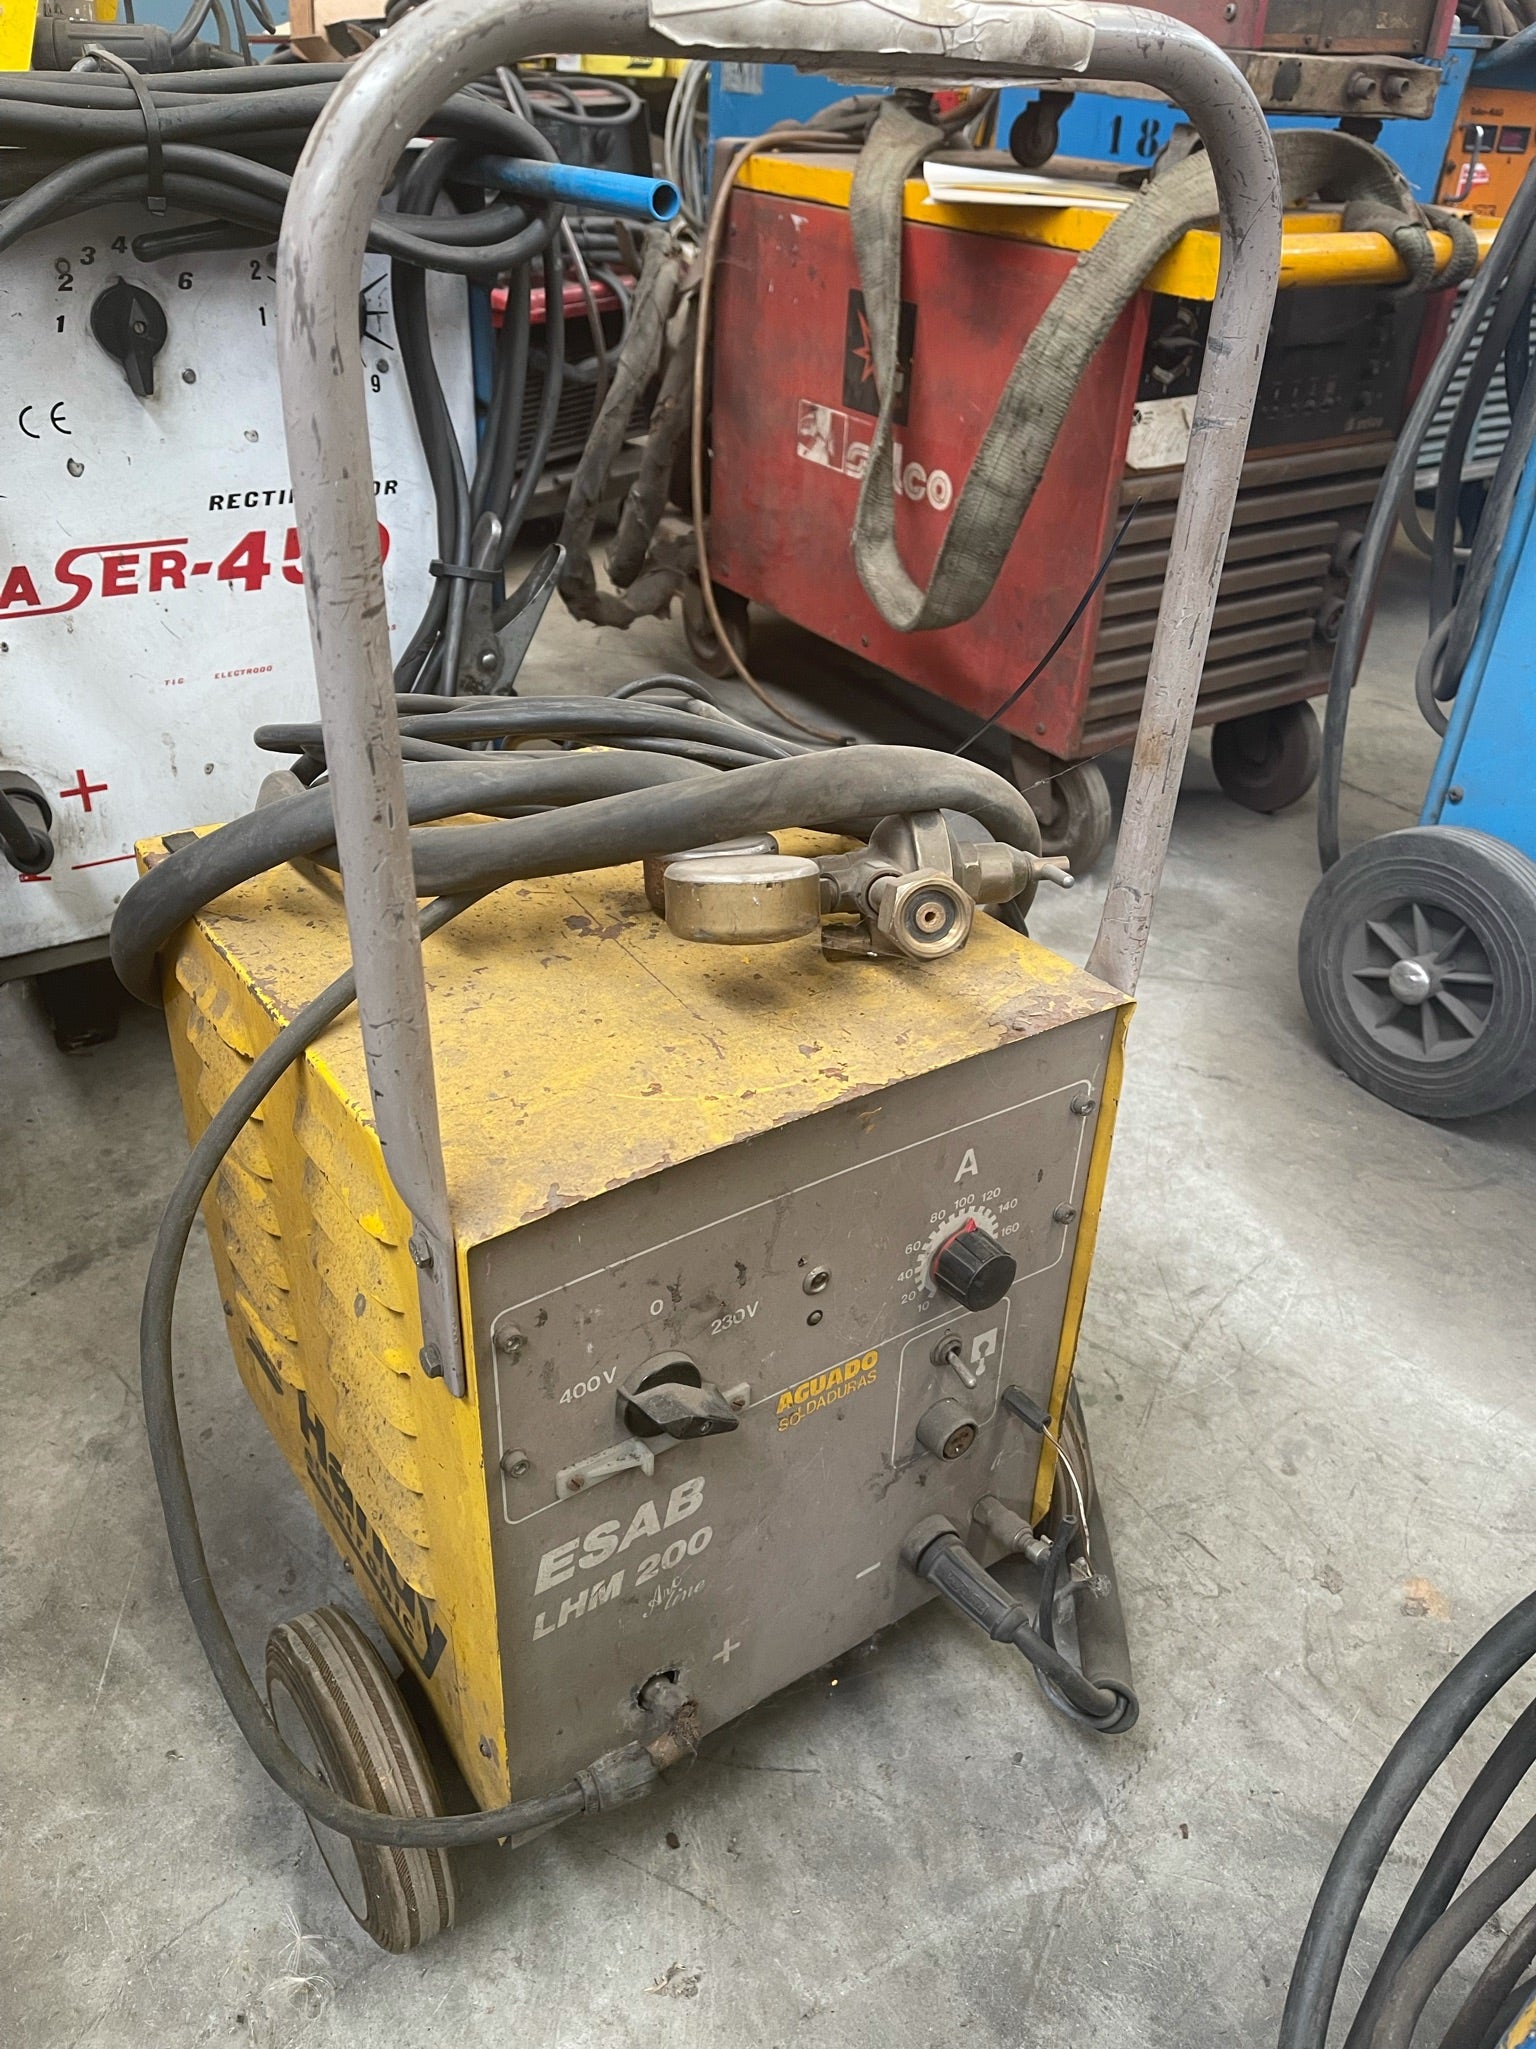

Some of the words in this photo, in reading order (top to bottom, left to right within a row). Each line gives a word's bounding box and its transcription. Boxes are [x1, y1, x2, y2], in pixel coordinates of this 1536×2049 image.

[111, 235, 128, 254] 4
[80, 246, 96, 266] 3
[250, 260, 261, 281] 2
[58, 273, 74, 292] 2
[178, 271, 194, 290] 6
[56, 315, 66, 333] 1
[259, 306, 266, 326] 1
[371, 374, 381, 393] 9
[19, 402, 72, 439] CE
[845, 440, 953, 512] slco
[164, 677, 185, 686] TIG
[953, 1147, 979, 1183] A
[953, 1193, 975, 1210] 100
[982, 1186, 1001, 1203] 120
[998, 1197, 1018, 1214] 140
[929, 1209, 947, 1224] 80
[1001, 1221, 1020, 1237] 160
[904, 1240, 921, 1255] 60
[896, 1268, 914, 1283] 40
[900, 1290, 916, 1305] 20
[917, 1300, 930, 1313] 10
[710, 1300, 760, 1336] 230V
[558, 1366, 618, 1405] 400V
[775, 1349, 880, 1416] AGUADO
[777, 1370, 878, 1433] SOLDADURAS
[533, 1475, 706, 1597] ESAB
[532, 1569, 626, 1642] LHM
[634, 1525, 714, 1588] 200
